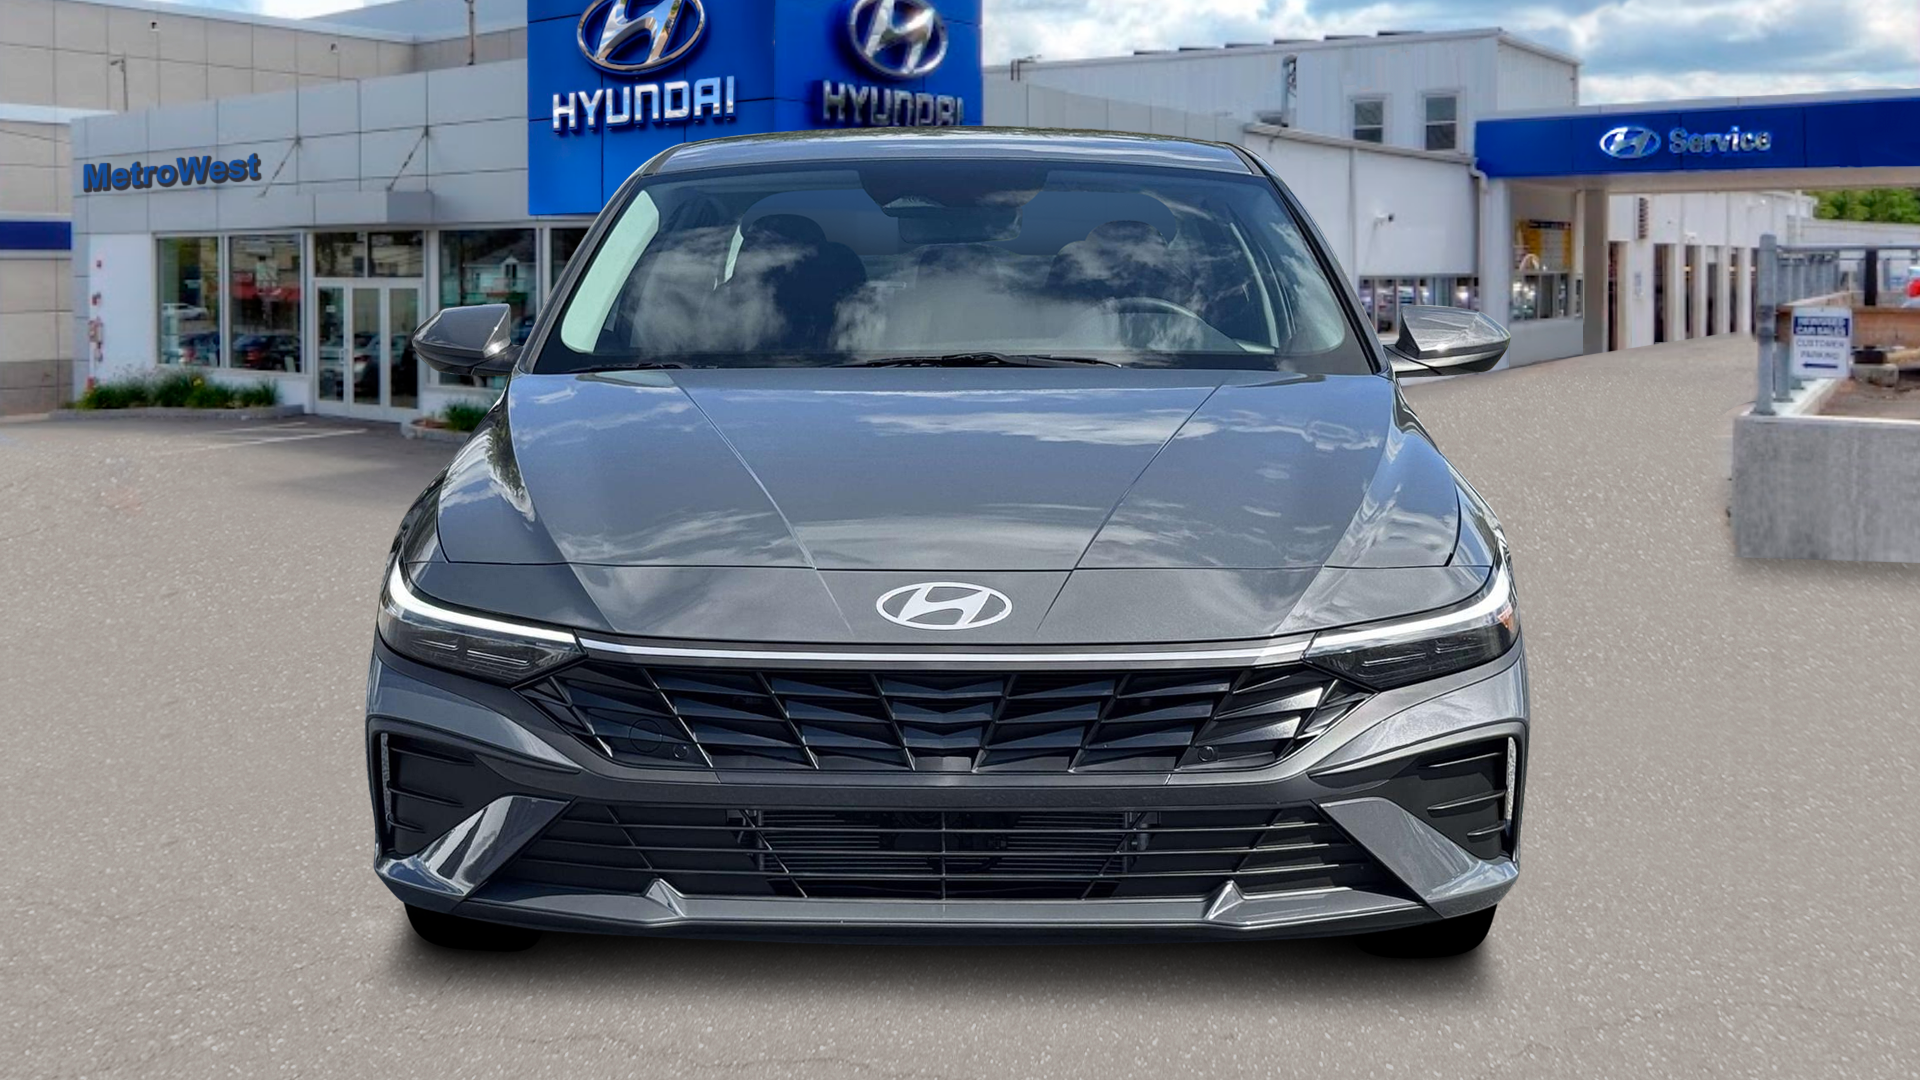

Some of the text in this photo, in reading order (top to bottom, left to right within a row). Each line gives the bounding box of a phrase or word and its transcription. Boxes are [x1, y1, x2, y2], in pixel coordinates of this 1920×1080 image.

[552, 76, 735, 131] HYUNDAI
[822, 80, 964, 126] HYUNDAI
[1669, 125, 1771, 153] Service
[83, 153, 261, 193] MetroWest
[1796, 339, 1845, 348] CUSTOMER
[1800, 350, 1840, 360] PARKING
